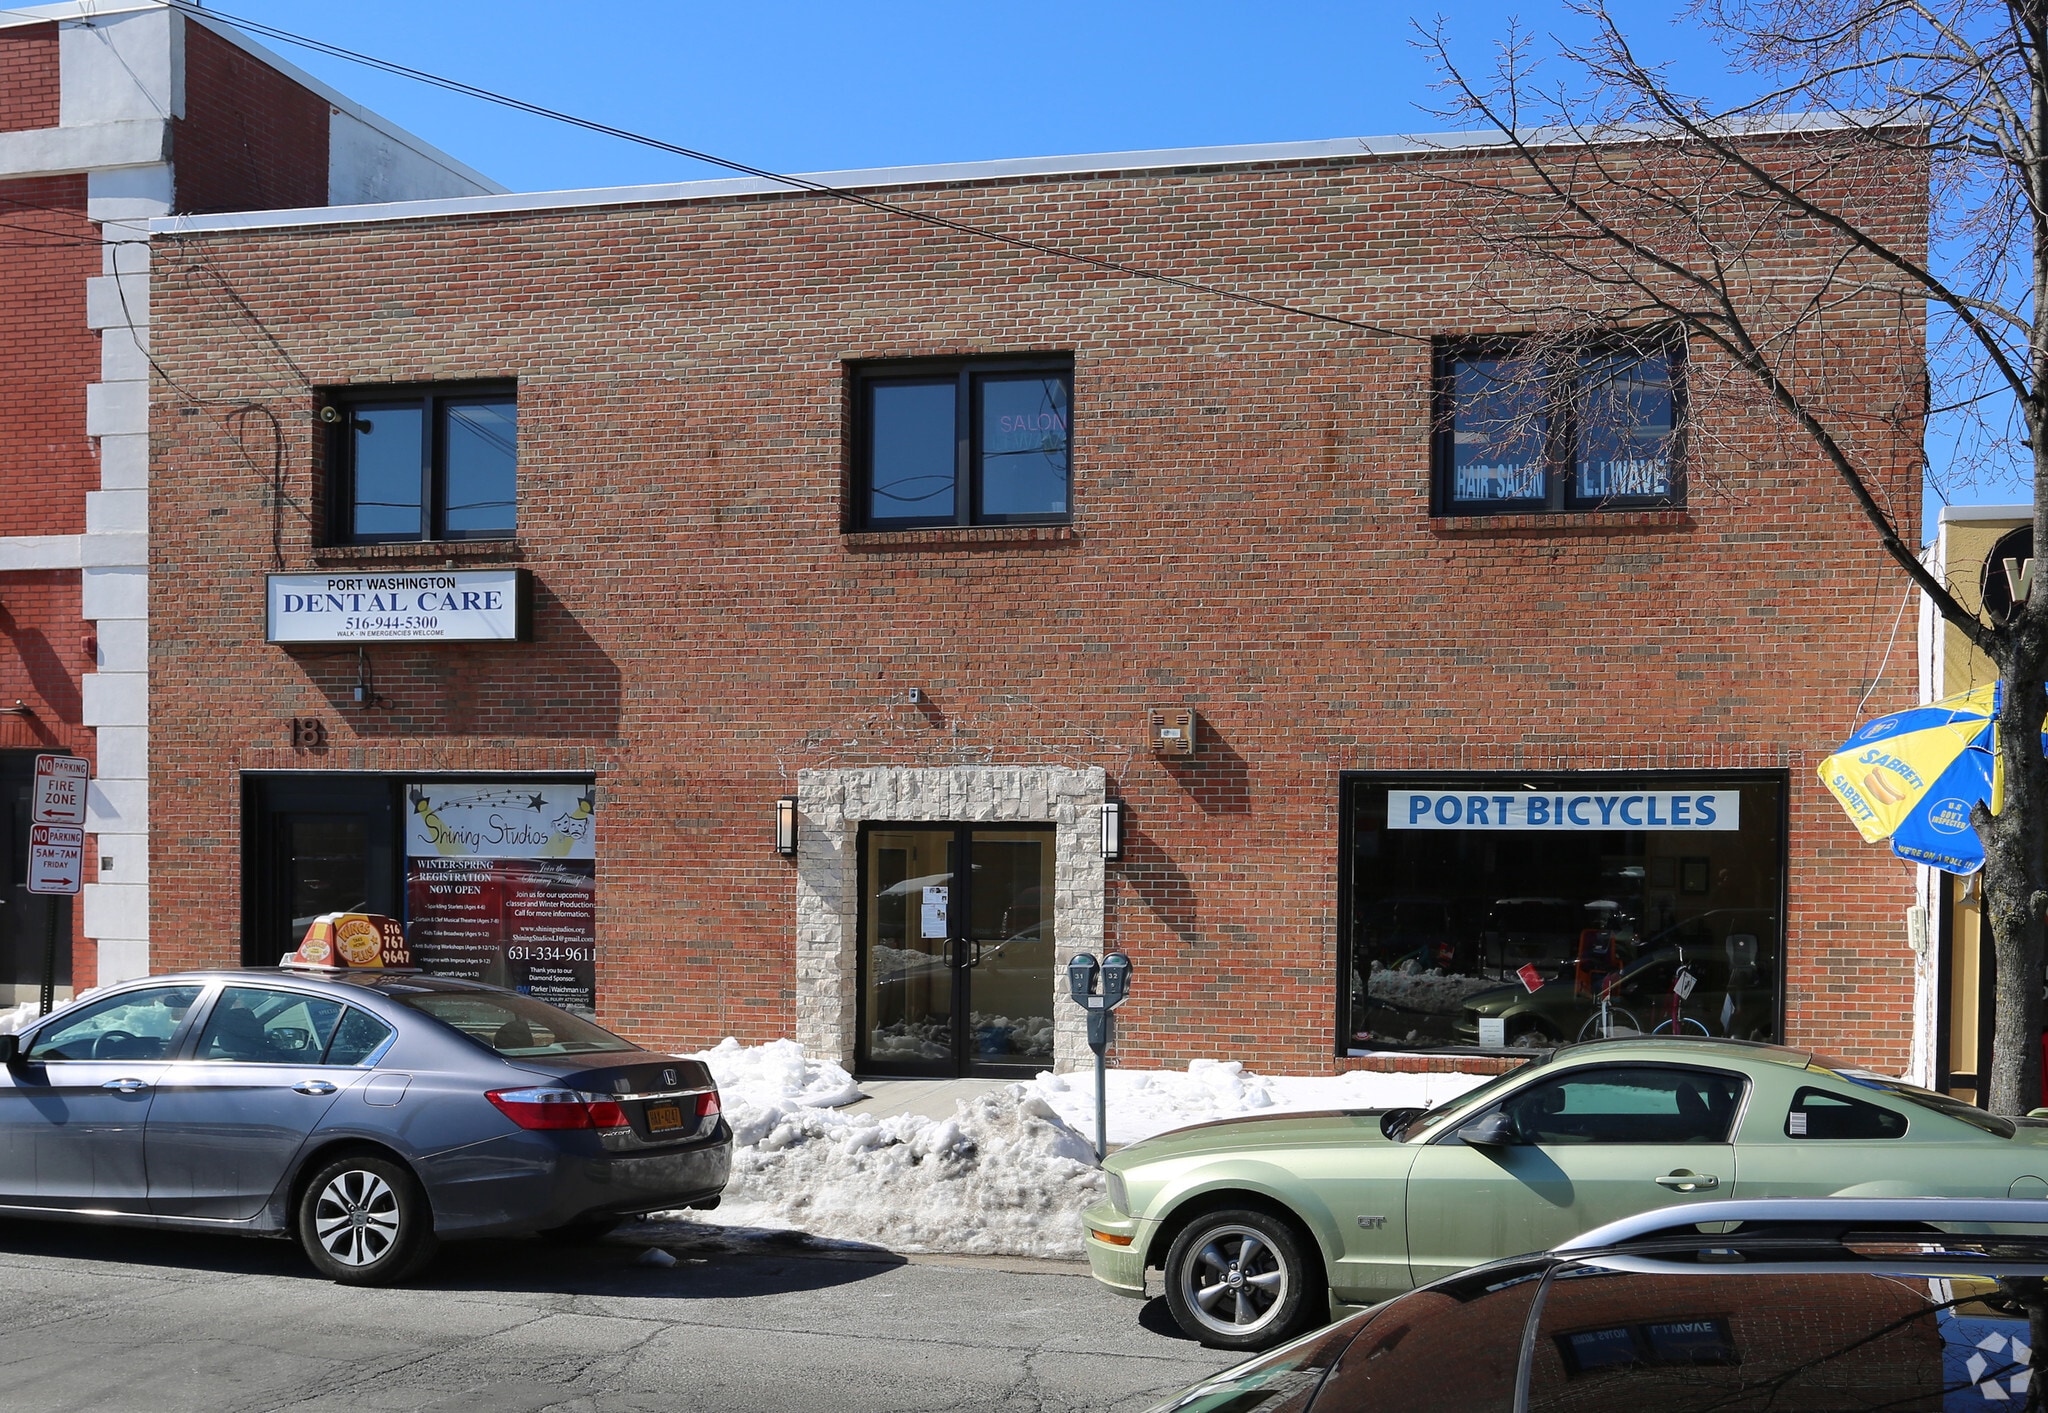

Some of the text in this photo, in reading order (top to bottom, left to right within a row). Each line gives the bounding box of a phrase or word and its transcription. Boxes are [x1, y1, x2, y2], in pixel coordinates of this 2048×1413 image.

[1000, 413, 1067, 433] SALON
[1457, 463, 1545, 499] HAIR SALON
[328, 577, 456, 590] PORT WASHINGTON
[282, 591, 503, 613] DENTAL CARE
[345, 616, 438, 630] 516-944-5300
[286, 718, 320, 747] 18
[38, 759, 86, 774] NO PARKING
[1858, 749, 1924, 790] SABRETT
[48, 780, 75, 792] FIRE
[45, 793, 76, 805] ZONE
[1832, 775, 1874, 820] SABRETT
[1409, 795, 1717, 826] PORT BICYCLES
[1931, 816, 1966, 829] INSPECTED
[34, 829, 80, 842] NO PARKING
[418, 814, 549, 853] Shining Studios
[1898, 845, 1922, 857] WE'RE
[1923, 851, 1936, 860] ON
[1944, 855, 1962, 866] ROLL
[417, 860, 494, 869] WINTER-SPRING
[420, 872, 492, 882] REGISTRATION
[429, 885, 481, 894] NOW OPEN
[558, 892, 589, 900] upcoming
[338, 922, 370, 942] WINGS
[384, 924, 400, 934] 516
[383, 936, 403, 948] 767
[352, 946, 374, 962] PLUS
[383, 950, 410, 963] 9647
[508, 946, 597, 961] 631-334-9611
[1358, 1215, 1385, 1227] GT
